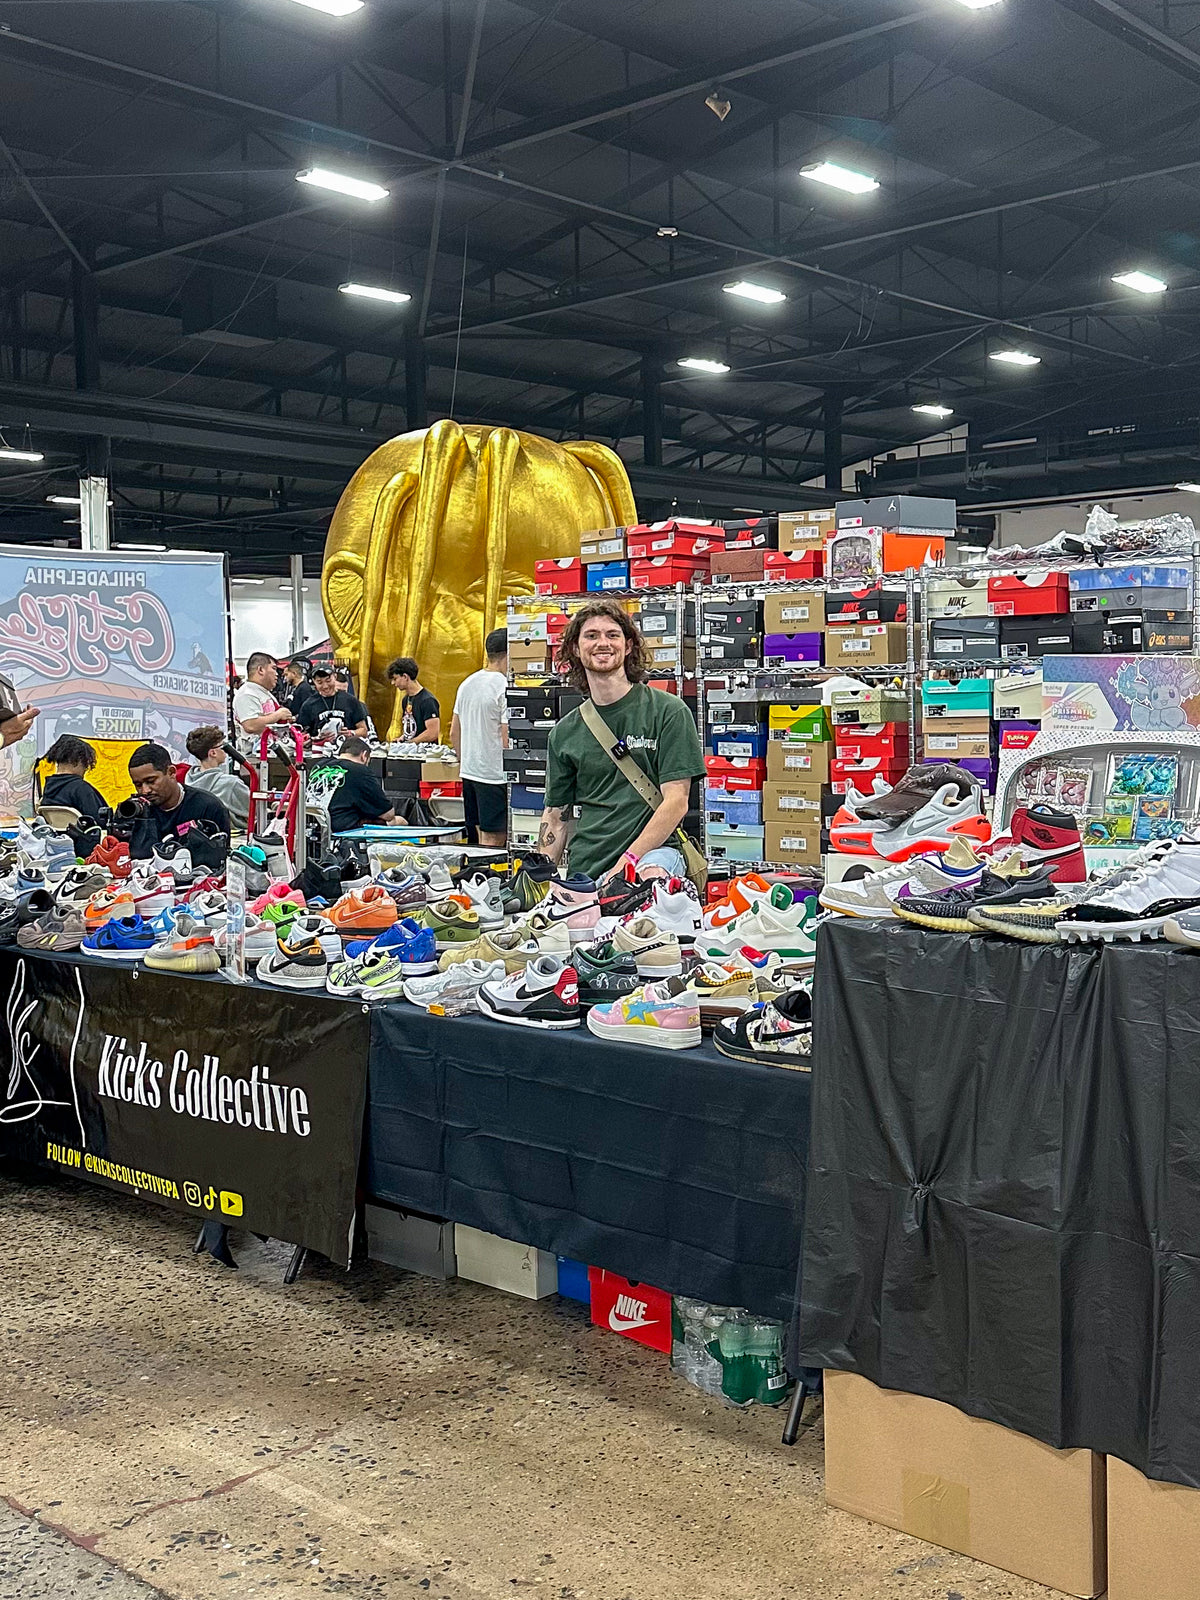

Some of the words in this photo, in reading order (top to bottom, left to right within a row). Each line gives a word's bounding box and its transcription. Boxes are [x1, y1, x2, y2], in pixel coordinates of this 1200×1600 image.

[842, 602, 860, 612] NIKE
[948, 596, 967, 606] NIKE
[1052, 707, 1097, 718] PRISMATIC
[98, 1034, 164, 1109] Kicks
[169, 1049, 311, 1137] Collective
[47, 1142, 82, 1168] FOLLOW
[84, 1153, 180, 1200] @KICKSCOLLECTIVEPA
[615, 1293, 648, 1321] NIKE
